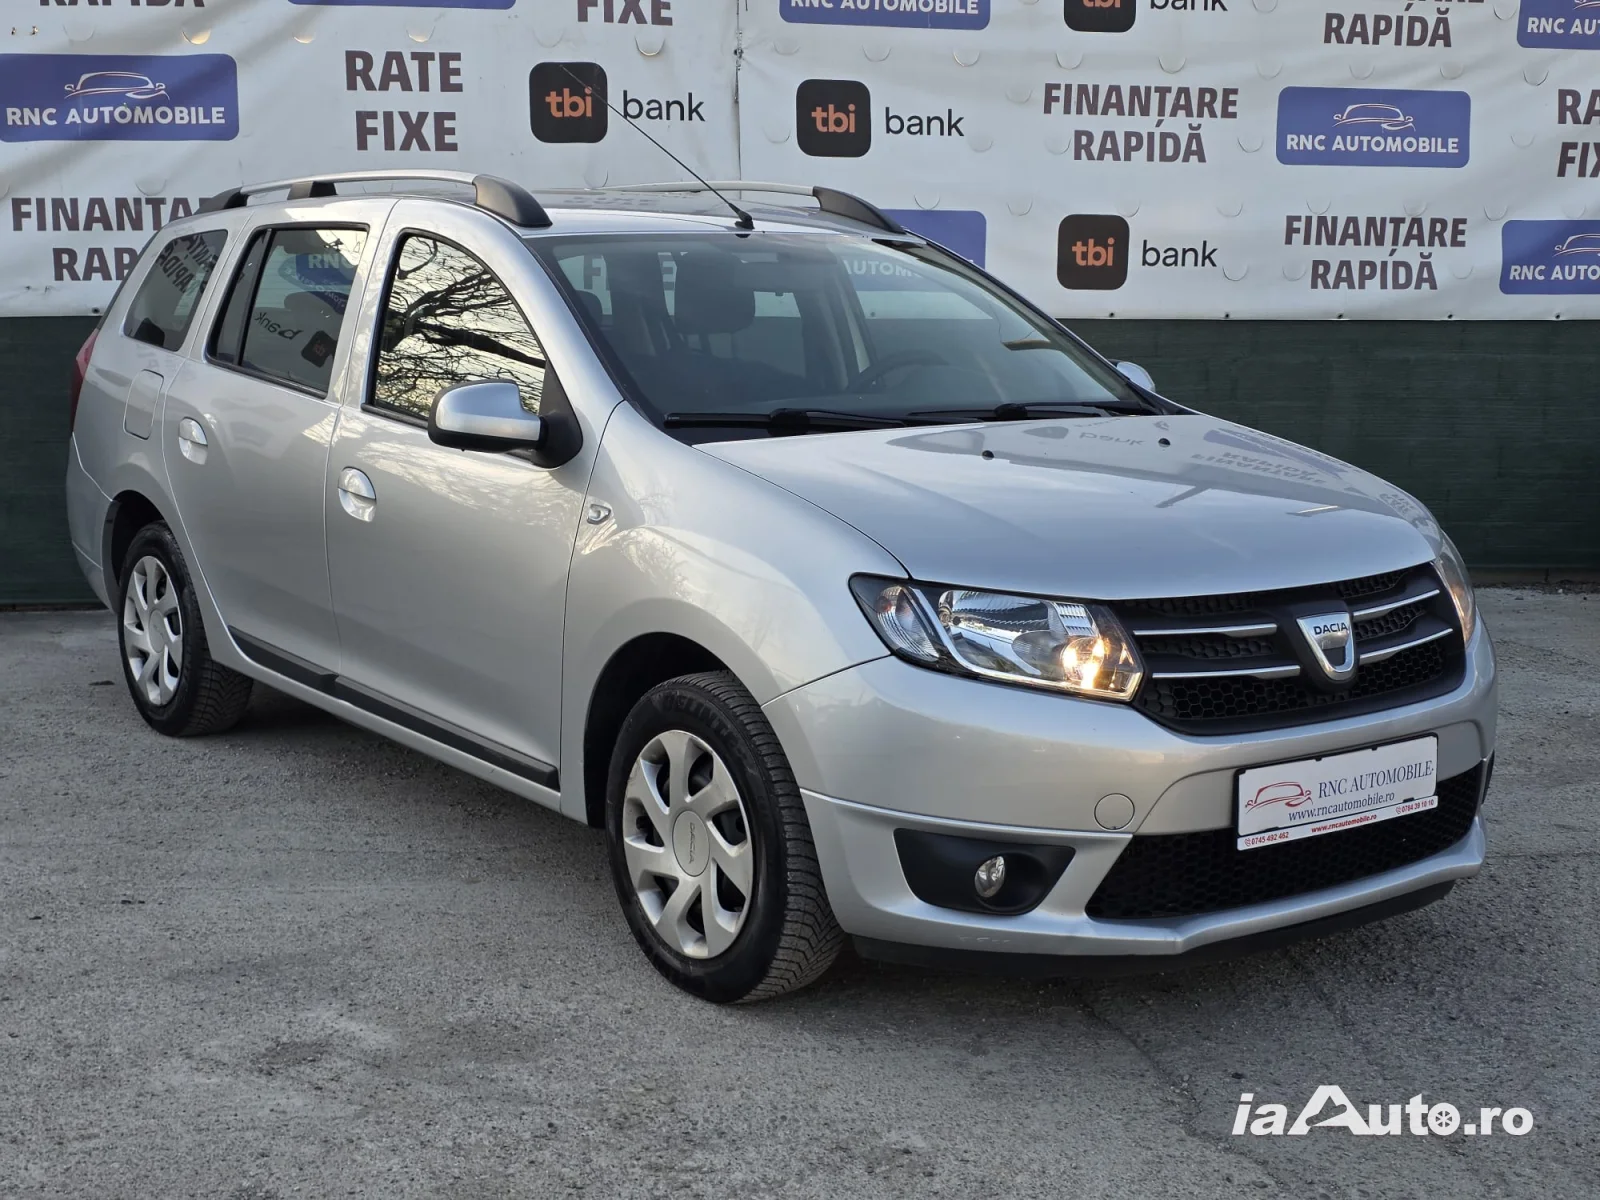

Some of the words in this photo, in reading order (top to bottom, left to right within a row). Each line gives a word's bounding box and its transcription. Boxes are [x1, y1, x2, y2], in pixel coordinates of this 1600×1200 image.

[1527, 17, 1566, 34] RNC
[1569, 18, 1600, 35] AU
[345, 50, 463, 92] RATE
[6, 108, 57, 125] RNC
[65, 106, 225, 124] AUTOMOBILE
[545, 86, 593, 118] tbi
[623, 90, 705, 121] bank
[355, 111, 458, 151] FIXE
[811, 104, 856, 133] tbi
[885, 106, 965, 136] bank
[1286, 134, 1326, 151] RNC
[1332, 135, 1459, 154] AUTOMOBILE
[1071, 237, 1115, 267] tbi
[1141, 239, 1218, 268] bank
[1509, 265, 1546, 281] RNC
[1313, 622, 1348, 635] DACIA
[1318, 778, 1348, 798] RNC
[1350, 760, 1433, 793] AUTOMOBILE
[1288, 792, 1395, 822] www.rncautomobile.ro
[1311, 814, 1377, 833] www.rncautomobile.ro
